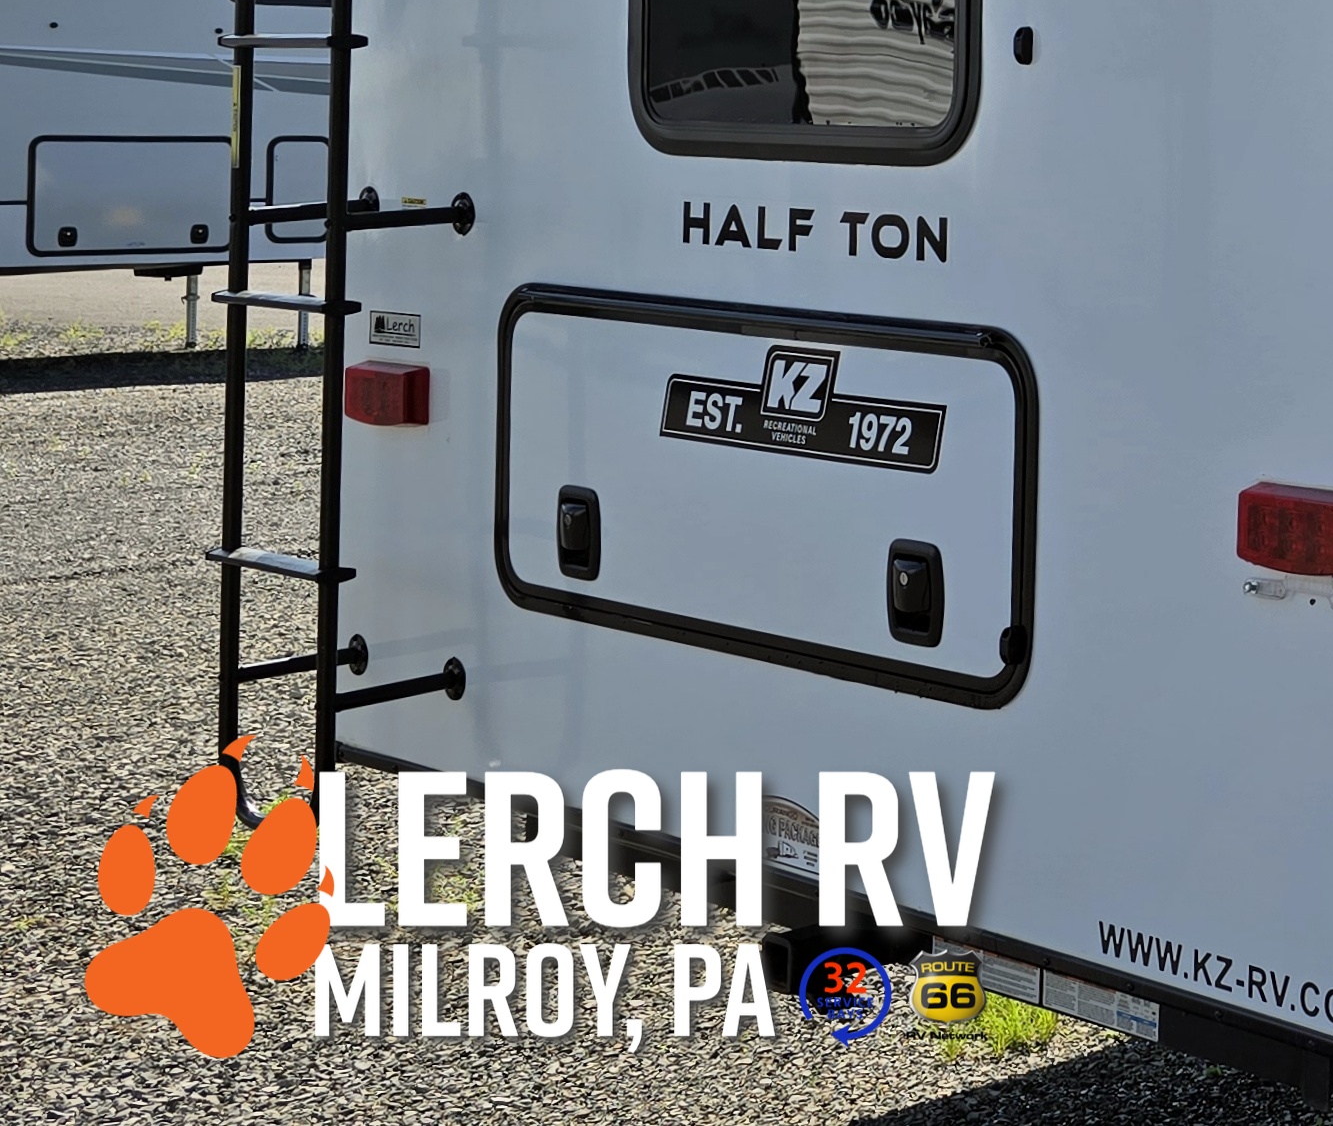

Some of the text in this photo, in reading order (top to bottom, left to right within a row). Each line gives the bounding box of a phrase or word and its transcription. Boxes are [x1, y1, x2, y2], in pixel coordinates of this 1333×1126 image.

[682, 200, 949, 263] HALF TON
[386, 316, 415, 334] Lerch
[766, 359, 828, 414] KZ
[689, 390, 743, 434] EST.
[763, 419, 818, 436] RECREATIONAL
[848, 411, 913, 455] 1972
[771, 431, 807, 445] VEHICLES
